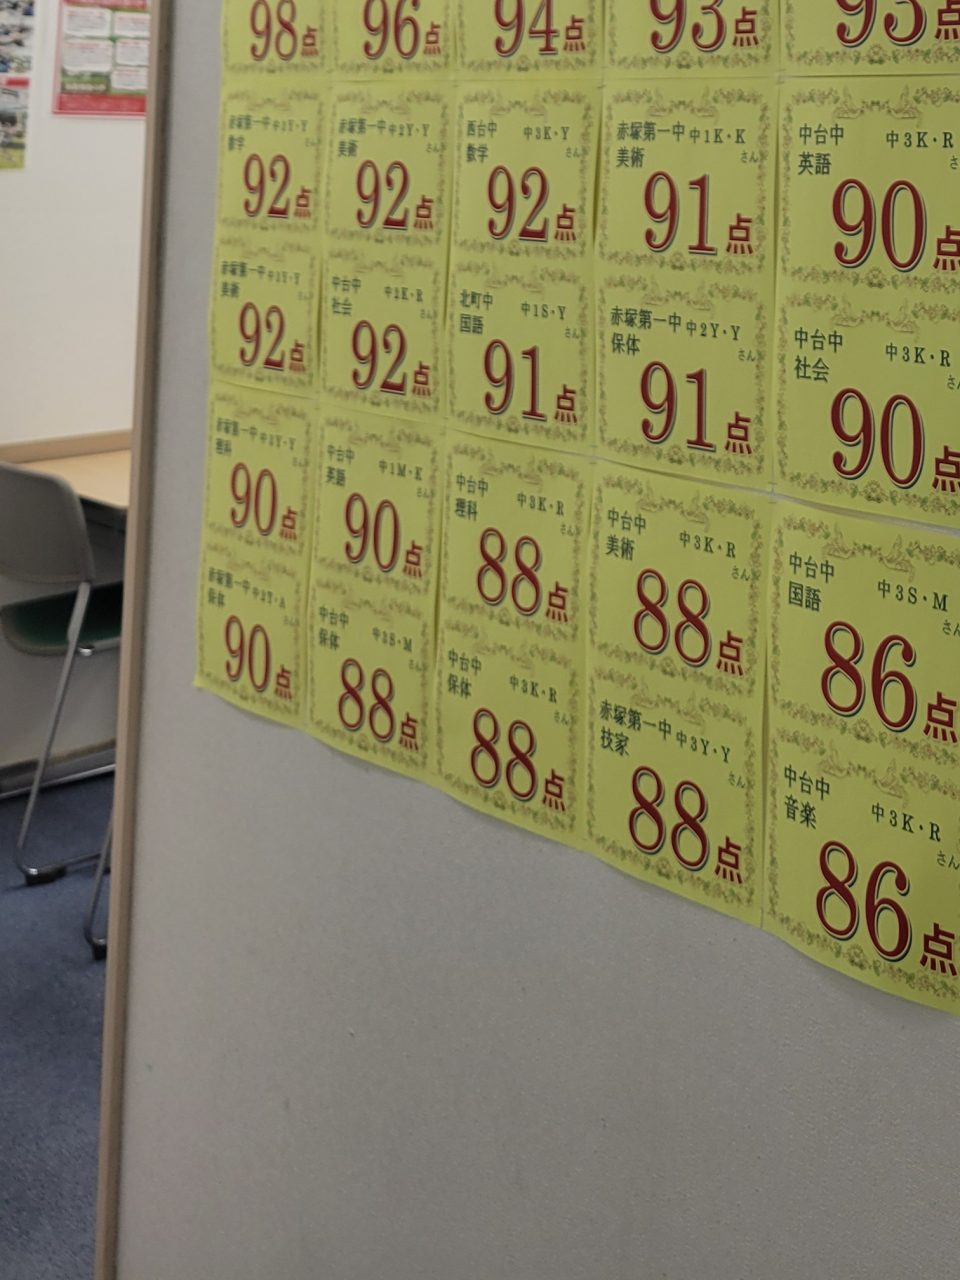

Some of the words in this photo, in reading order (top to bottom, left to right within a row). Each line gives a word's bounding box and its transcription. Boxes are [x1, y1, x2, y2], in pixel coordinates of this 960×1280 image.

[466, 120, 497, 139] 西台中
[617, 120, 686, 141] 赤塚第一中
[798, 123, 844, 147] 中台中
[885, 130, 954, 149] 中3K・R
[466, 142, 489, 163] 数学
[616, 146, 645, 169] 美術
[798, 151, 832, 176] 英語
[243, 153, 312, 219] 92点
[356, 159, 434, 230] 92点
[487, 165, 577, 242] 92点
[643, 169, 755, 256] 91点
[460, 290, 493, 310] 北町中
[610, 305, 682, 333] 赤塚第一中
[239, 301, 306, 373] 92点
[460, 313, 484, 335] 国語
[352, 320, 432, 397] 92点
[610, 332, 640, 358] 保体
[794, 327, 844, 354] 中台中
[885, 342, 951, 367] 中3K・R
[484, 339, 578, 423] 91点
[794, 355, 829, 383] 社会
[640, 360, 753, 455] 91点
[230, 462, 299, 540] 90点
[455, 473, 488, 496] 中台中
[455, 499, 478, 521] 理科
[607, 508, 647, 533] 中台中
[344, 492, 424, 578] 90点
[605, 534, 636, 562] 美術
[476, 527, 569, 623] 88点
[789, 551, 836, 584] 中台中
[877, 578, 949, 613] 中3S・M
[788, 582, 823, 613] 国語
[633, 568, 746, 678] 88点
[224, 614, 293, 700] 90点
[448, 648, 482, 674] 中台中
[447, 674, 472, 698] 保体
[821, 620, 959, 744] 86点
[338, 657, 419, 752] 88点
[599, 699, 672, 742] 赤塚第一中
[470, 707, 567, 812] 88点
[599, 728, 630, 758] 技家
[783, 764, 832, 799] 中台中
[872, 802, 942, 843] 中3K・R
[783, 794, 818, 830] 音楽
[628, 765, 744, 885] 88点
[937, 849, 960, 870] さん
[815, 840, 959, 977] 86点
